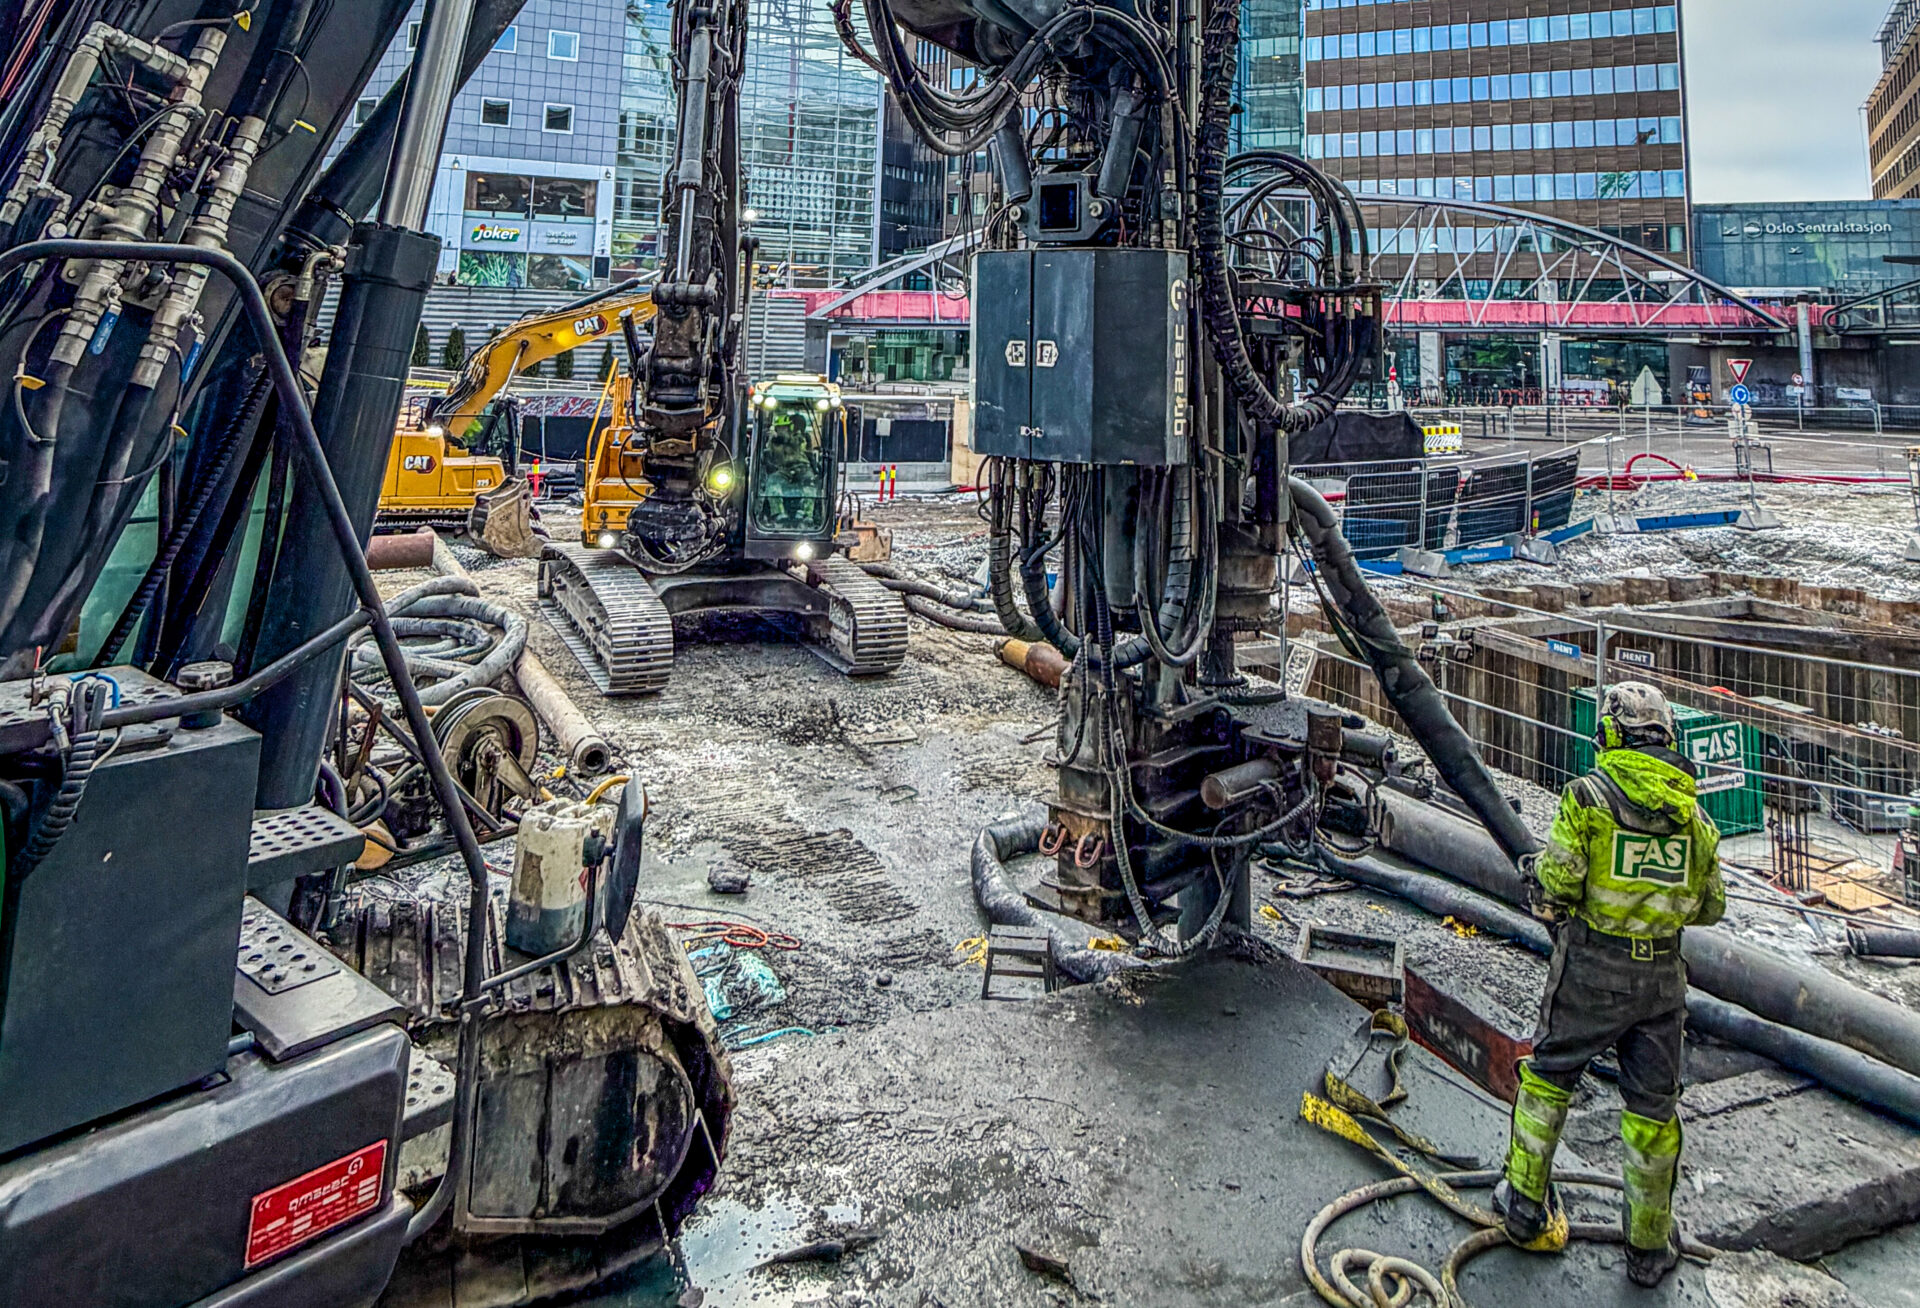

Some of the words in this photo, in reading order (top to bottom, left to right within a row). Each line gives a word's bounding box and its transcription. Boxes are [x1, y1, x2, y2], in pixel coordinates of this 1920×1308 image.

[474, 224, 517, 242] joker
[1765, 222, 1795, 234] Oslo
[1797, 221, 1892, 235] Sentralstasjon
[574, 315, 601, 336] CAT
[405, 455, 430, 470] CAT
[1553, 643, 1574, 655] HENT
[1622, 651, 1648, 663] HENT
[1692, 729, 1737, 776] FAS
[1736, 775, 1744, 783] AS
[1621, 838, 1683, 875] FAS
